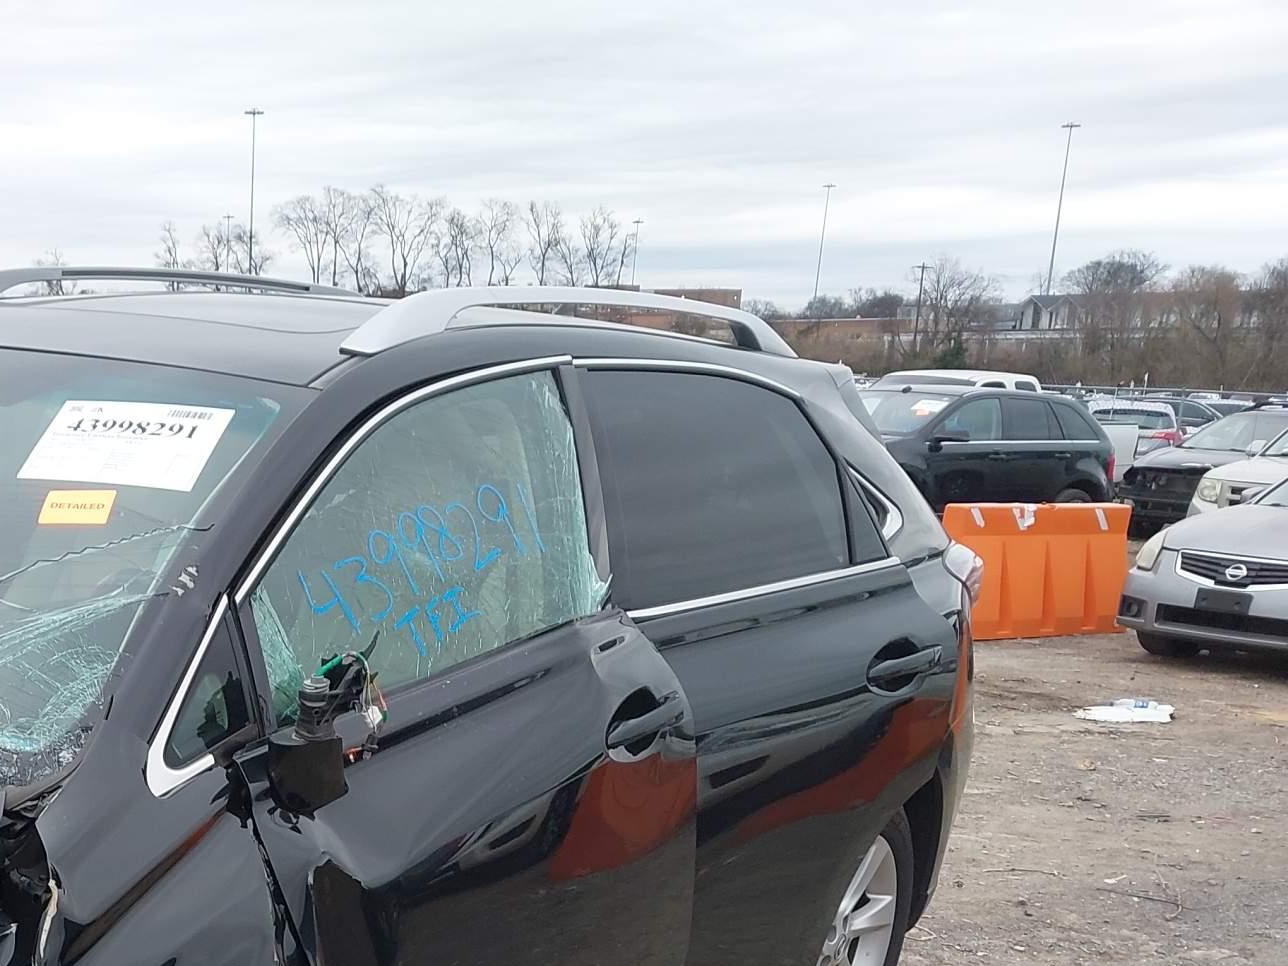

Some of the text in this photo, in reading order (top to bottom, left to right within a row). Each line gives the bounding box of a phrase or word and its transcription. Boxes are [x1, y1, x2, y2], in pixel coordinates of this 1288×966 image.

[66, 417, 199, 439] 43998291
[49, 502, 106, 511] DETAILED
[296, 483, 549, 635] 43998291
